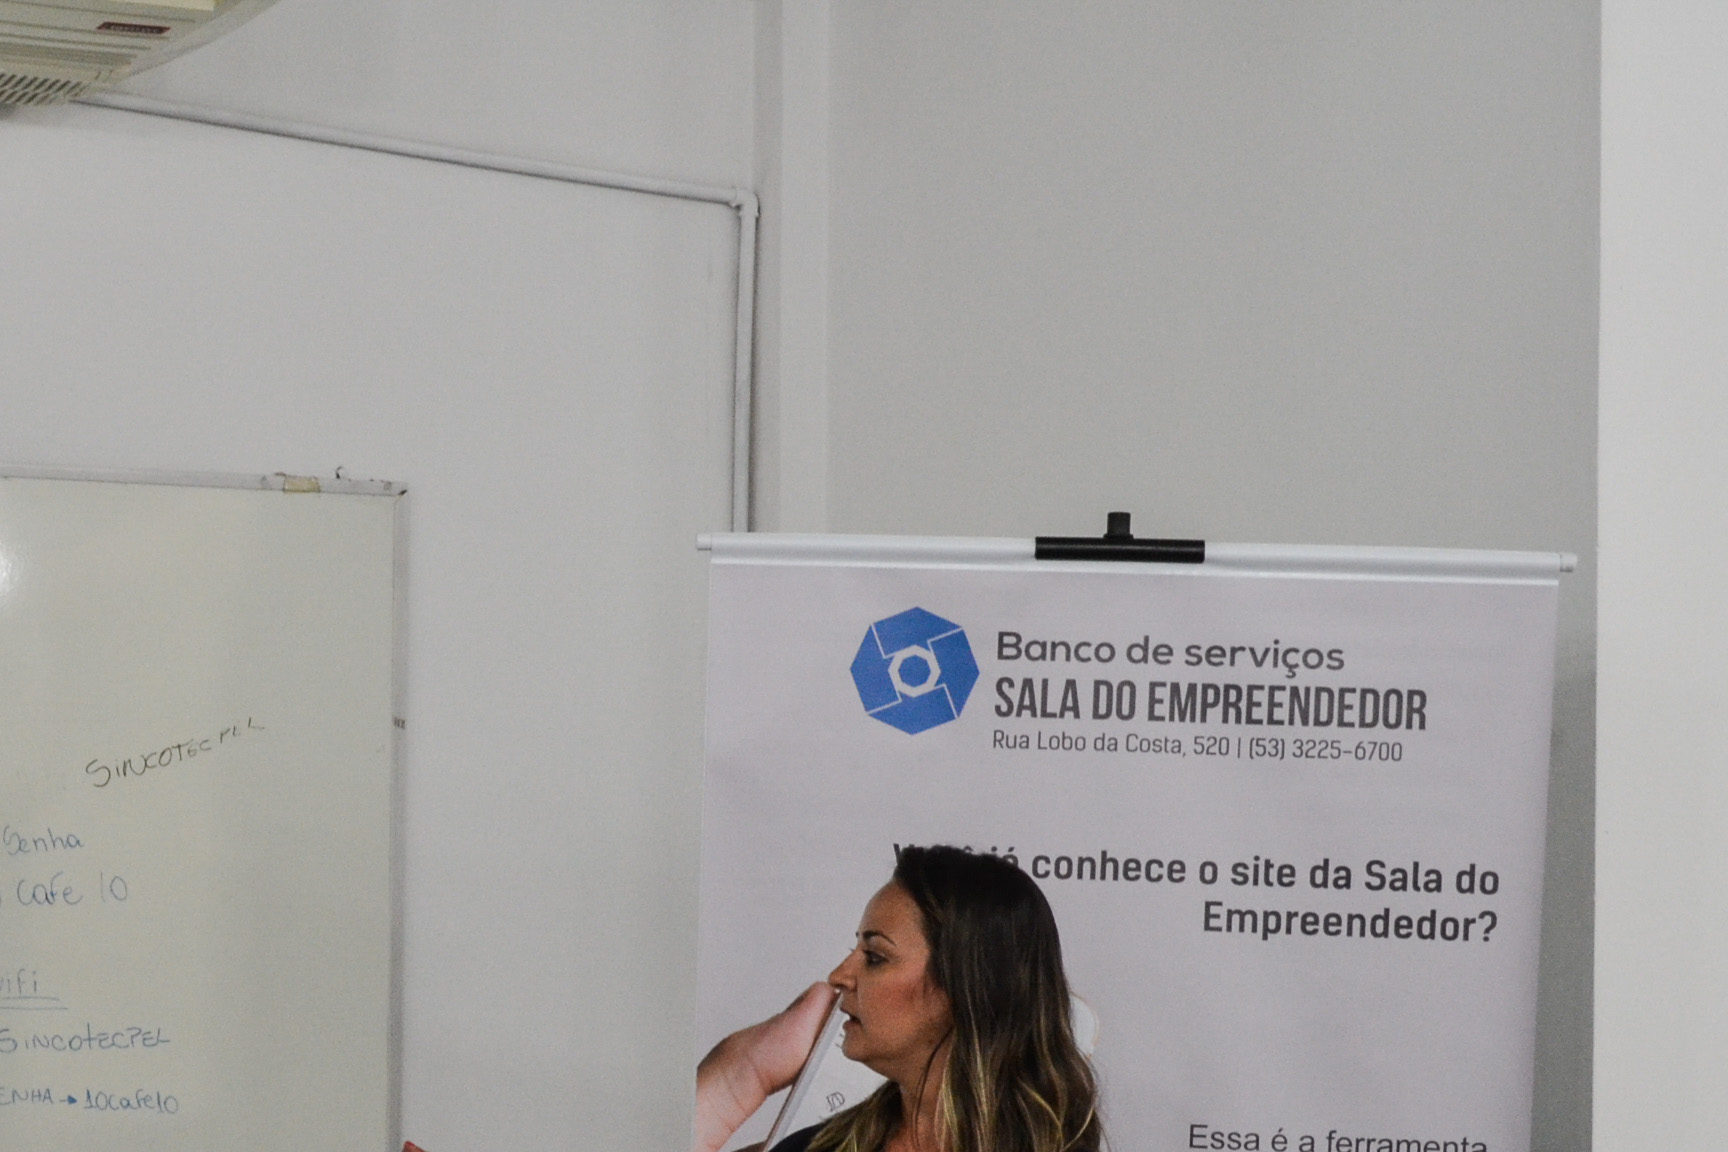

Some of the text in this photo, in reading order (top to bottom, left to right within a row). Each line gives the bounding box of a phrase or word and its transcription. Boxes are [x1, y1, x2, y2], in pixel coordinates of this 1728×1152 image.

[997, 631, 1346, 679] Banco de serviços
[994, 678, 1428, 731] SALA DO EMPREENDEDOR
[993, 731, 1030, 752] Rua
[1037, 731, 1085, 753] Lobo
[1092, 732, 1118, 755] da
[1125, 734, 1187, 759] Costa,
[1193, 735, 1230, 758] 520
[1248, 737, 1286, 762] (53)
[1292, 739, 1403, 763] 3225-6700
[2, 824, 85, 855] Senha
[1032, 853, 1187, 884] conhece
[1199, 860, 1219, 886] o
[1230, 855, 1296, 888] site
[1310, 858, 1353, 891] da
[1365, 859, 1443, 894] Sala
[1455, 862, 1500, 895] do
[1204, 901, 1497, 943] Empreendedor?
